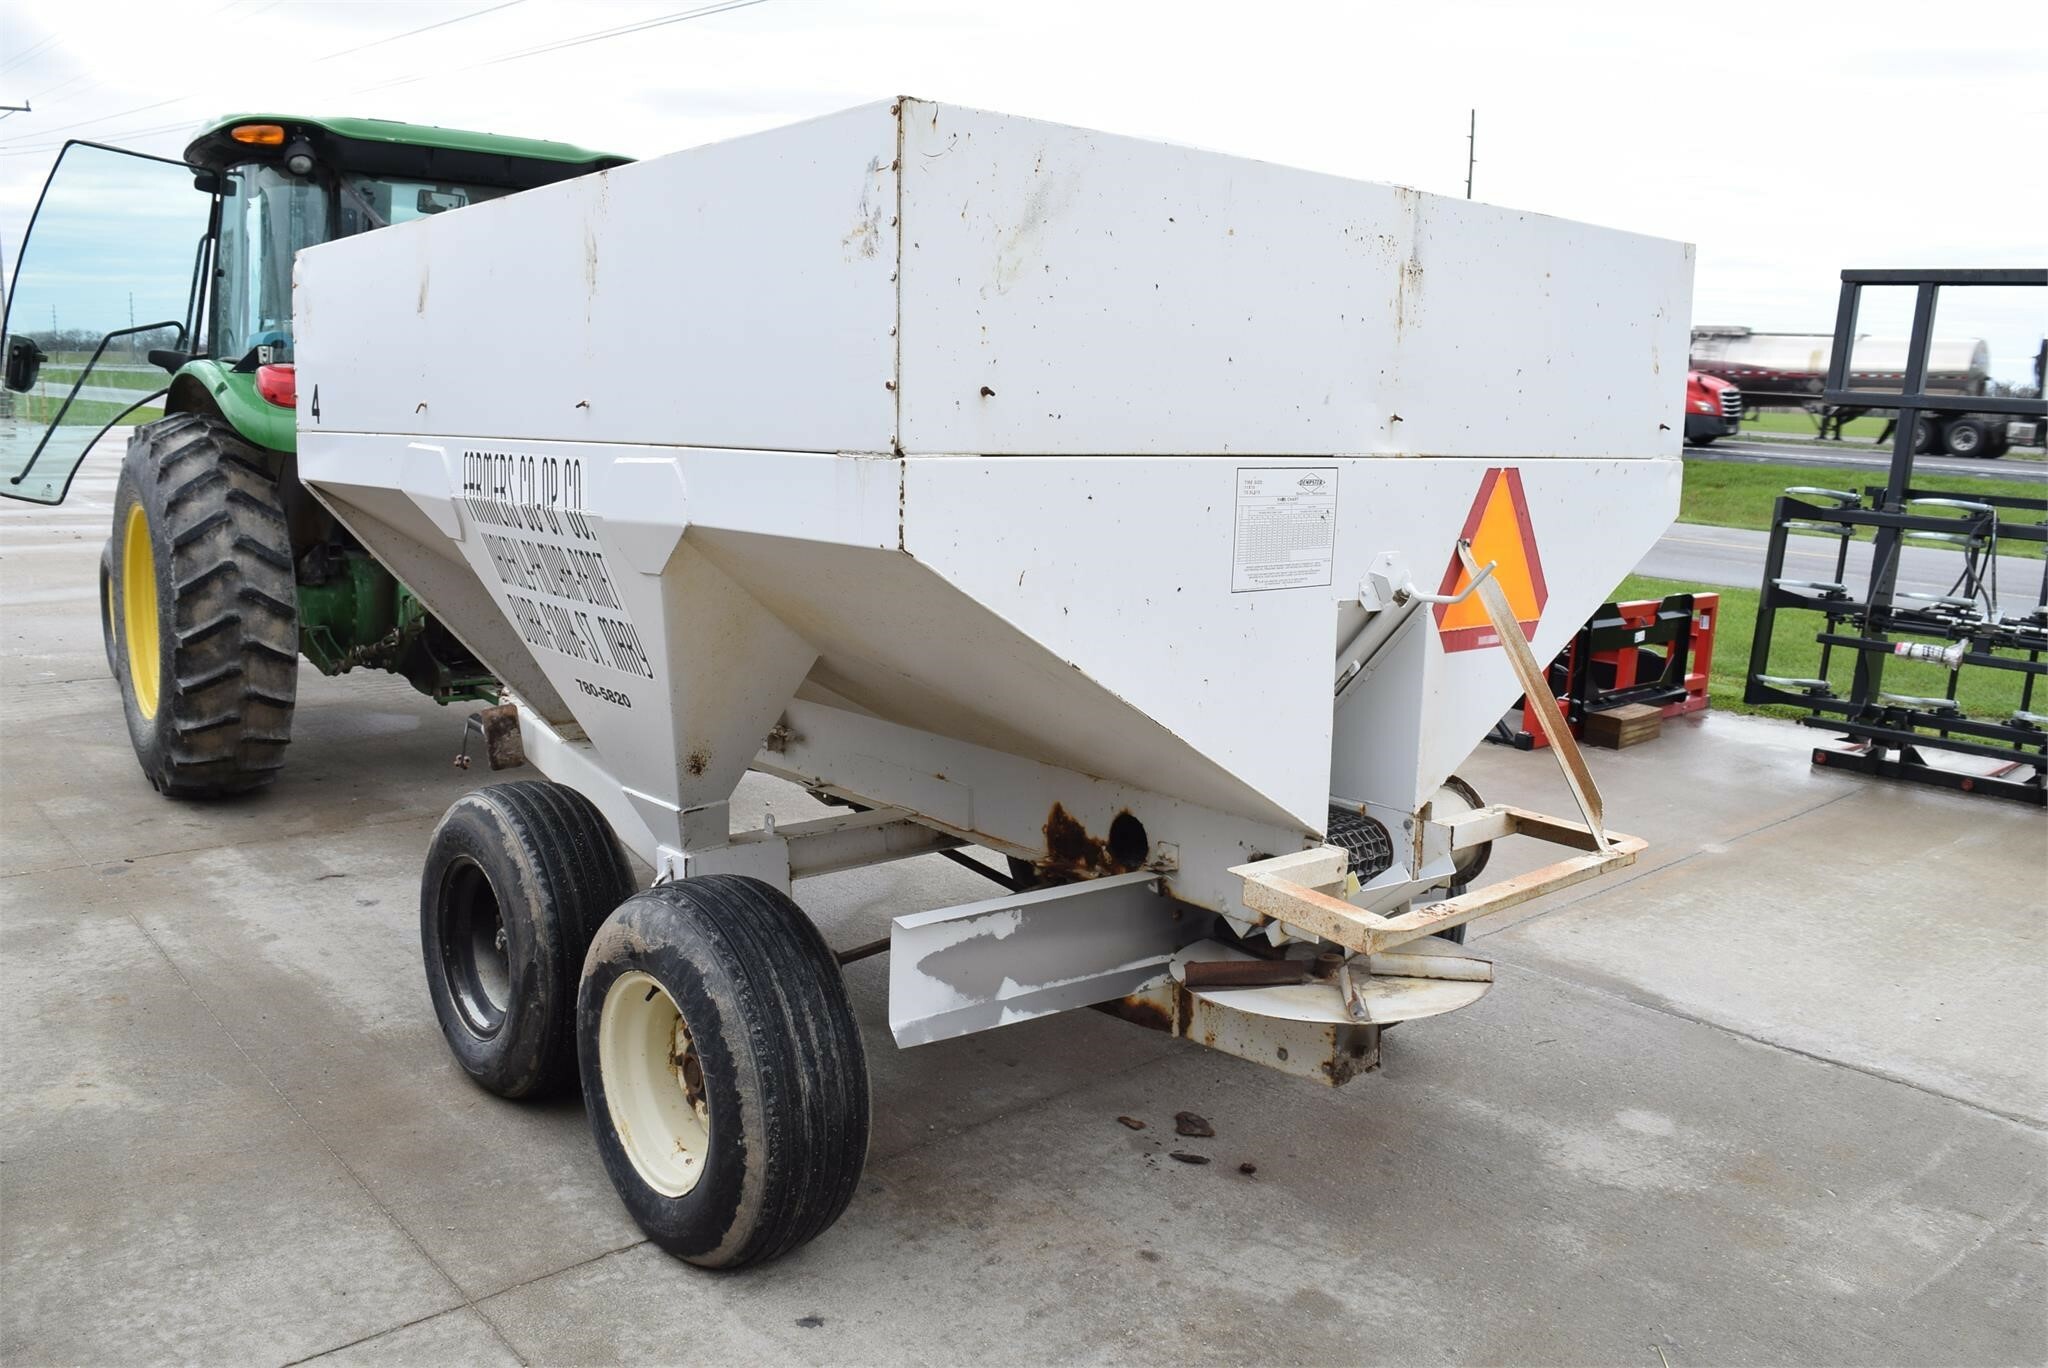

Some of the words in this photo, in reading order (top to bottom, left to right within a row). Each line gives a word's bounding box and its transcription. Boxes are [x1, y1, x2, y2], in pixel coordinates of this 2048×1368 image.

[311, 383, 321, 425] 4
[463, 450, 523, 530] FARMERS
[519, 455, 564, 537] CO-OP
[564, 458, 598, 541] CO.
[1299, 478, 1323, 486] DEMPSTER
[597, 615, 654, 679] MARY
[575, 678, 632, 709] 780-5820
